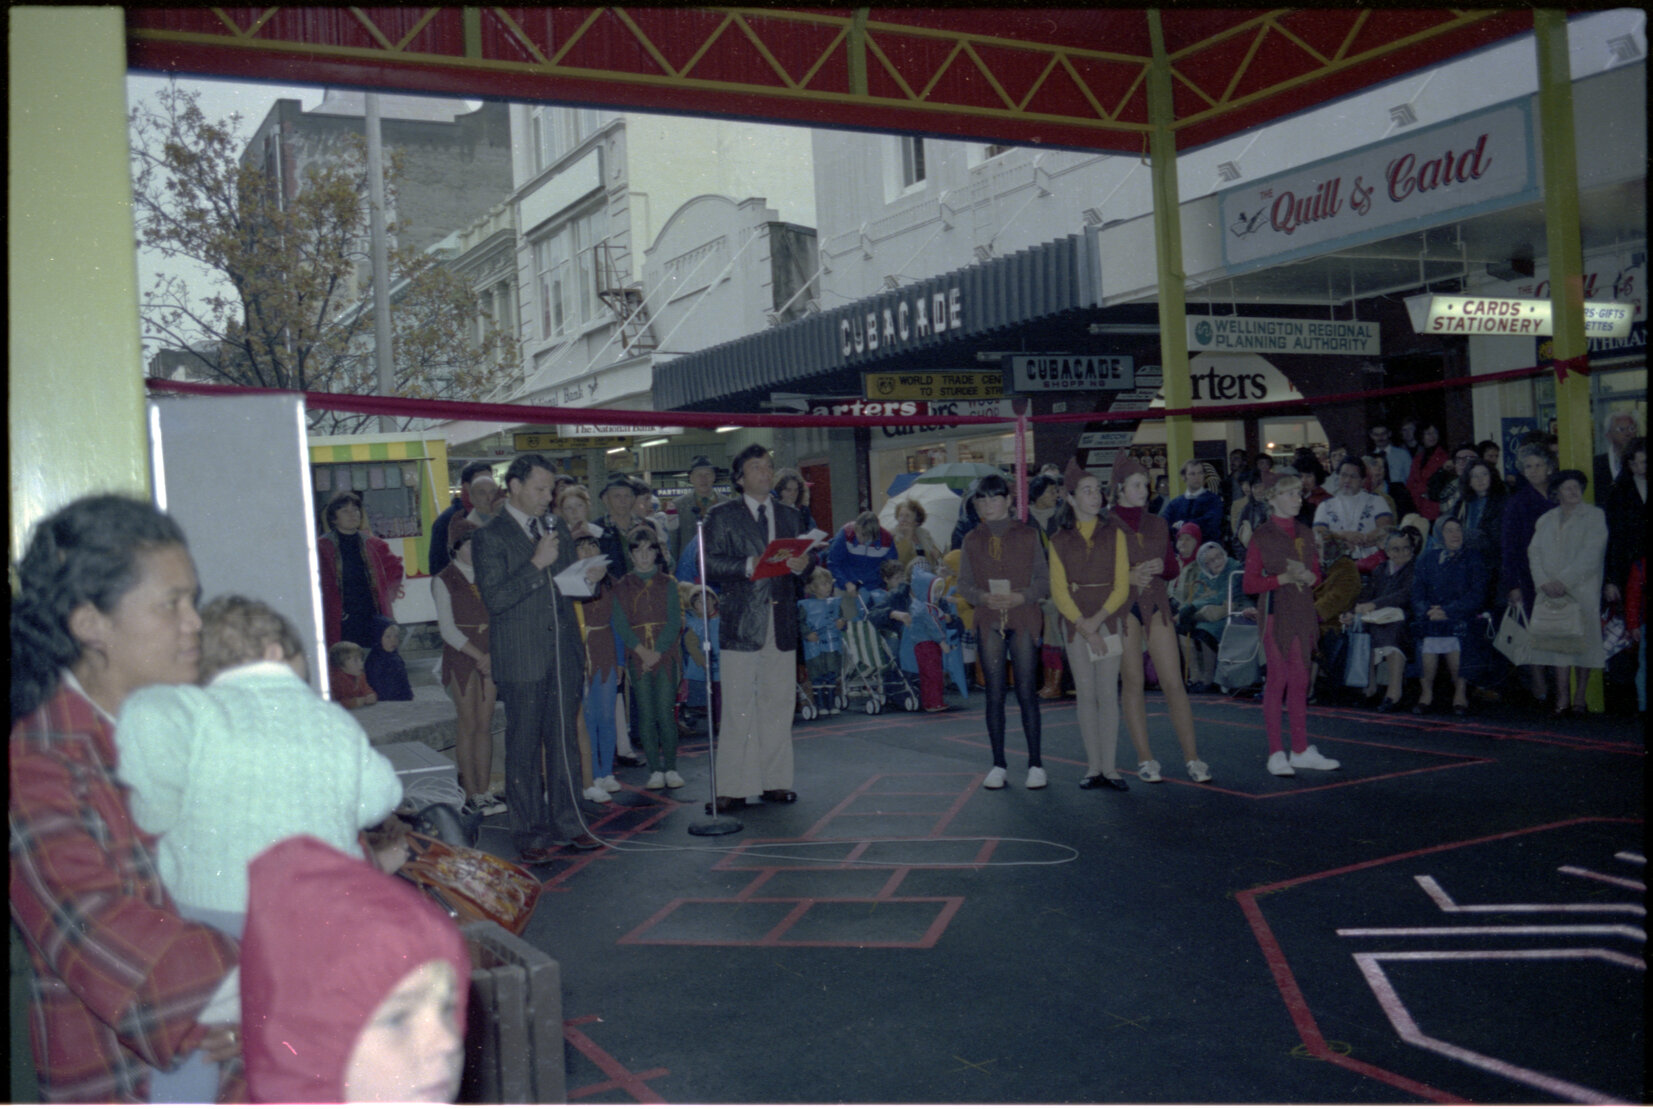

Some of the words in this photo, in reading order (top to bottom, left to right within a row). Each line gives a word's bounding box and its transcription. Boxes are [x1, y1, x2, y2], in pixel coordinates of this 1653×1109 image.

[1270, 177, 1343, 235] Quill
[1351, 176, 1374, 216] &
[1386, 133, 1493, 203] Card
[1260, 189, 1273, 199] THE
[1462, 301, 1522, 316] CARDS
[841, 287, 962, 356] CUBACADE
[1215, 320, 1303, 336] WELLINGTON
[1308, 324, 1372, 338] REGIONAL
[1433, 316, 1544, 333] STATIONERY
[1585, 321, 1614, 331] ETTES
[1216, 335, 1286, 349] PLANNING
[1293, 337, 1368, 350] AUTHORITY
[1026, 359, 1121, 380] CUBACADE
[899, 375, 933, 385] WORLD
[942, 375, 974, 385] TRADE
[982, 375, 1004, 384] CEN
[1190, 366, 1268, 400] rters
[920, 388, 933, 396] TO
[984, 386, 1004, 395] STR
